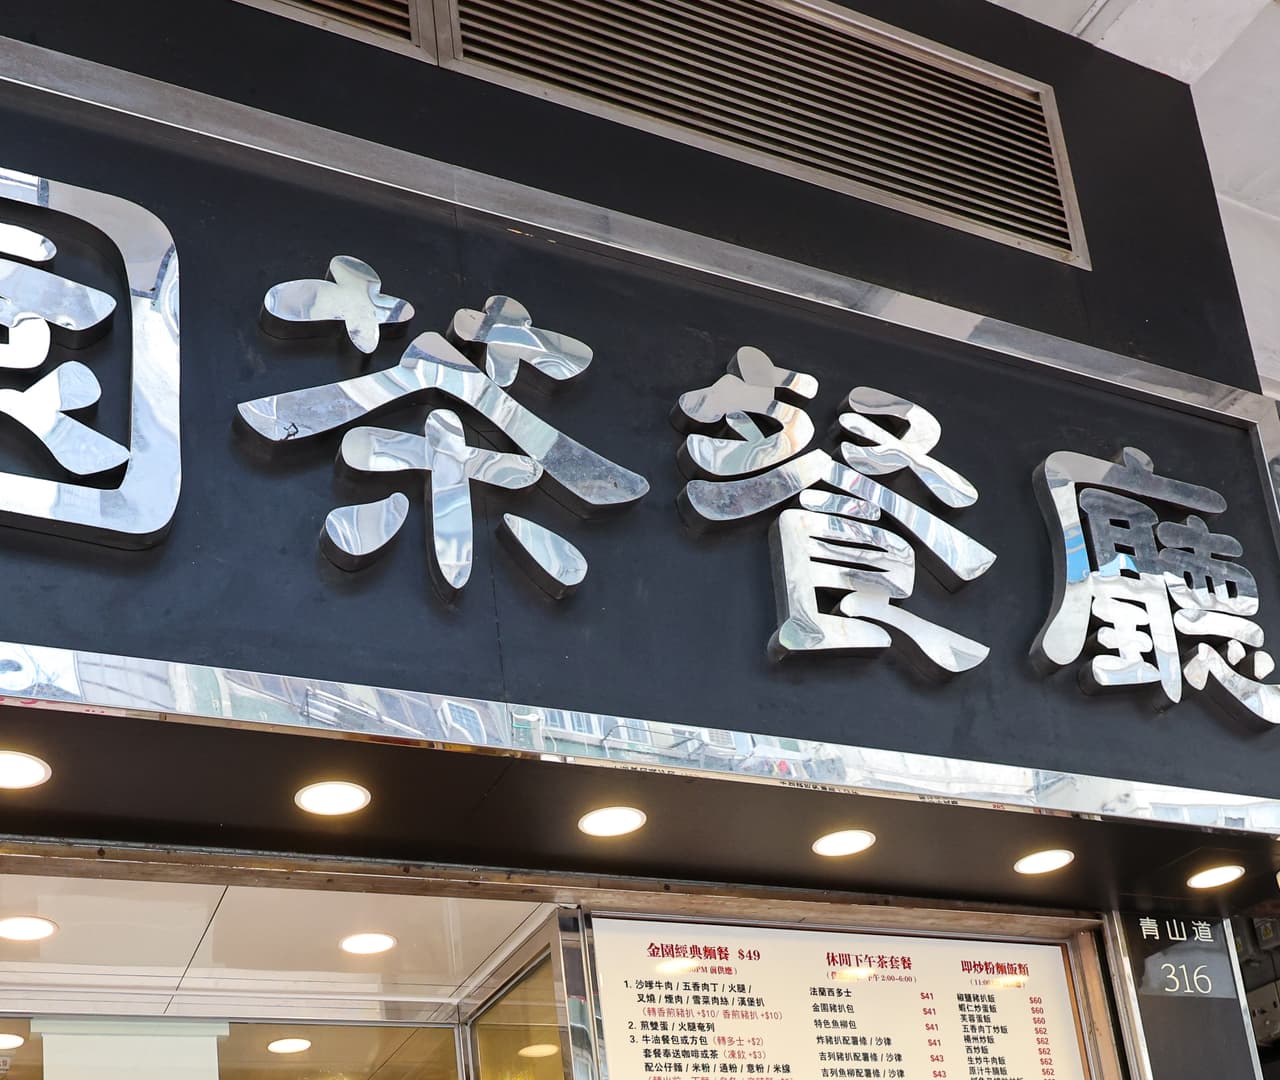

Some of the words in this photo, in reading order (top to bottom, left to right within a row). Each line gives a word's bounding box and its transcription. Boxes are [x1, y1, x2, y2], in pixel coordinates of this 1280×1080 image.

[1139, 917, 1214, 942] 青山道
[738, 949, 761, 961] $49
[1161, 963, 1212, 993] 316
[925, 1023, 939, 1031] $41
